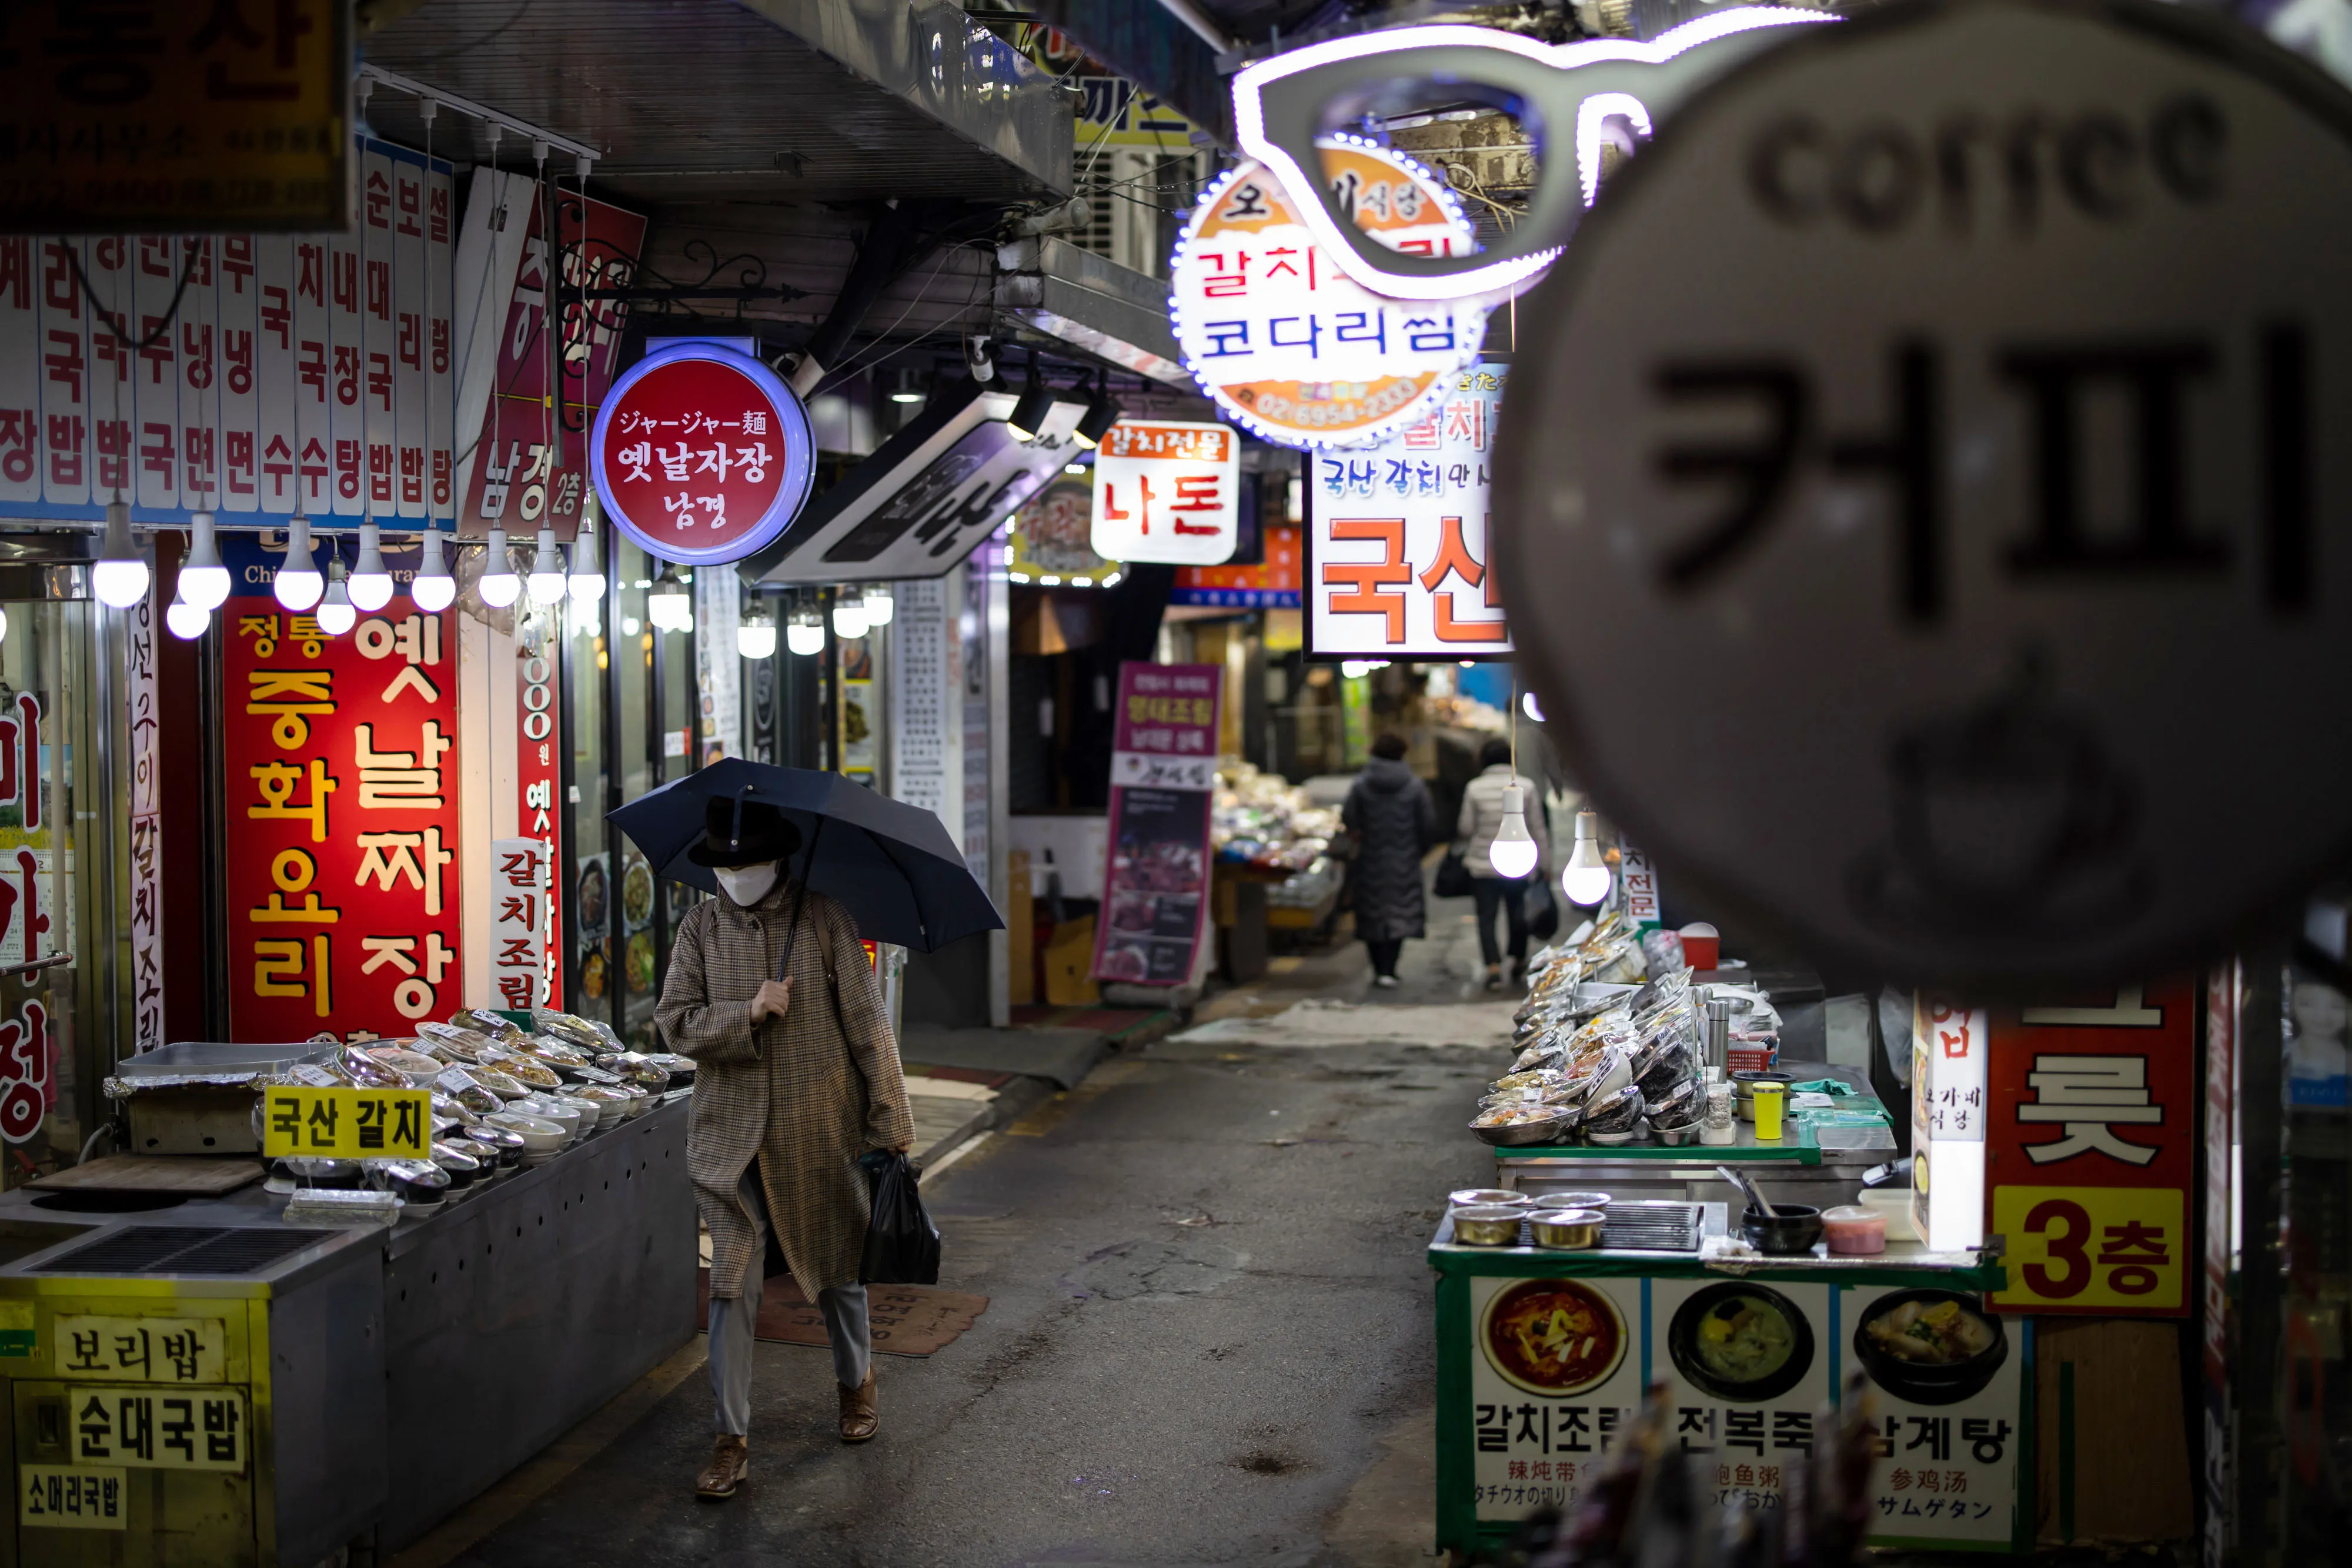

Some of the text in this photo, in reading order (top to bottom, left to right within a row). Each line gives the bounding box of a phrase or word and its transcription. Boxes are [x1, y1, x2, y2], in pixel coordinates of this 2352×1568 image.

[0, 0, 312, 105] 동산
[1751, 89, 2227, 235] coffee
[366, 170, 393, 502] 순대국밥
[397, 178, 424, 503] 보리밥
[261, 285, 293, 496] 국수
[298, 243, 329, 497] 치국수
[333, 250, 362, 499] 내장탕
[619, 410, 767, 436] ジャージャー麺
[1108, 427, 1224, 461] 갈치전문
[480, 439, 583, 521] 남경 2층
[617, 442, 773, 483] 옛날자장
[1656, 324, 2310, 620] 커피
[663, 490, 727, 530] 남경
[1104, 474, 1225, 536] 나돈
[239, 613, 336, 658] 정통
[246, 668, 341, 1017] 중화요리
[355, 612, 456, 1019] 옛날짜장
[496, 849, 544, 1011] 갈치조림
[272, 1097, 421, 1149] 국산 갈치
[2022, 1198, 2170, 1299] 3층
[66, 1328, 206, 1380] 보리밥
[79, 1395, 239, 1462] 순대국밥
[1678, 1407, 1813, 1459] 전복죽
[28, 1473, 119, 1517] 소머리국밥
[1508, 1460, 1588, 1482] 辣炖带
[1890, 1467, 1967, 1493] 参鸡汤
[1878, 1497, 1992, 1519] サムゲタン
